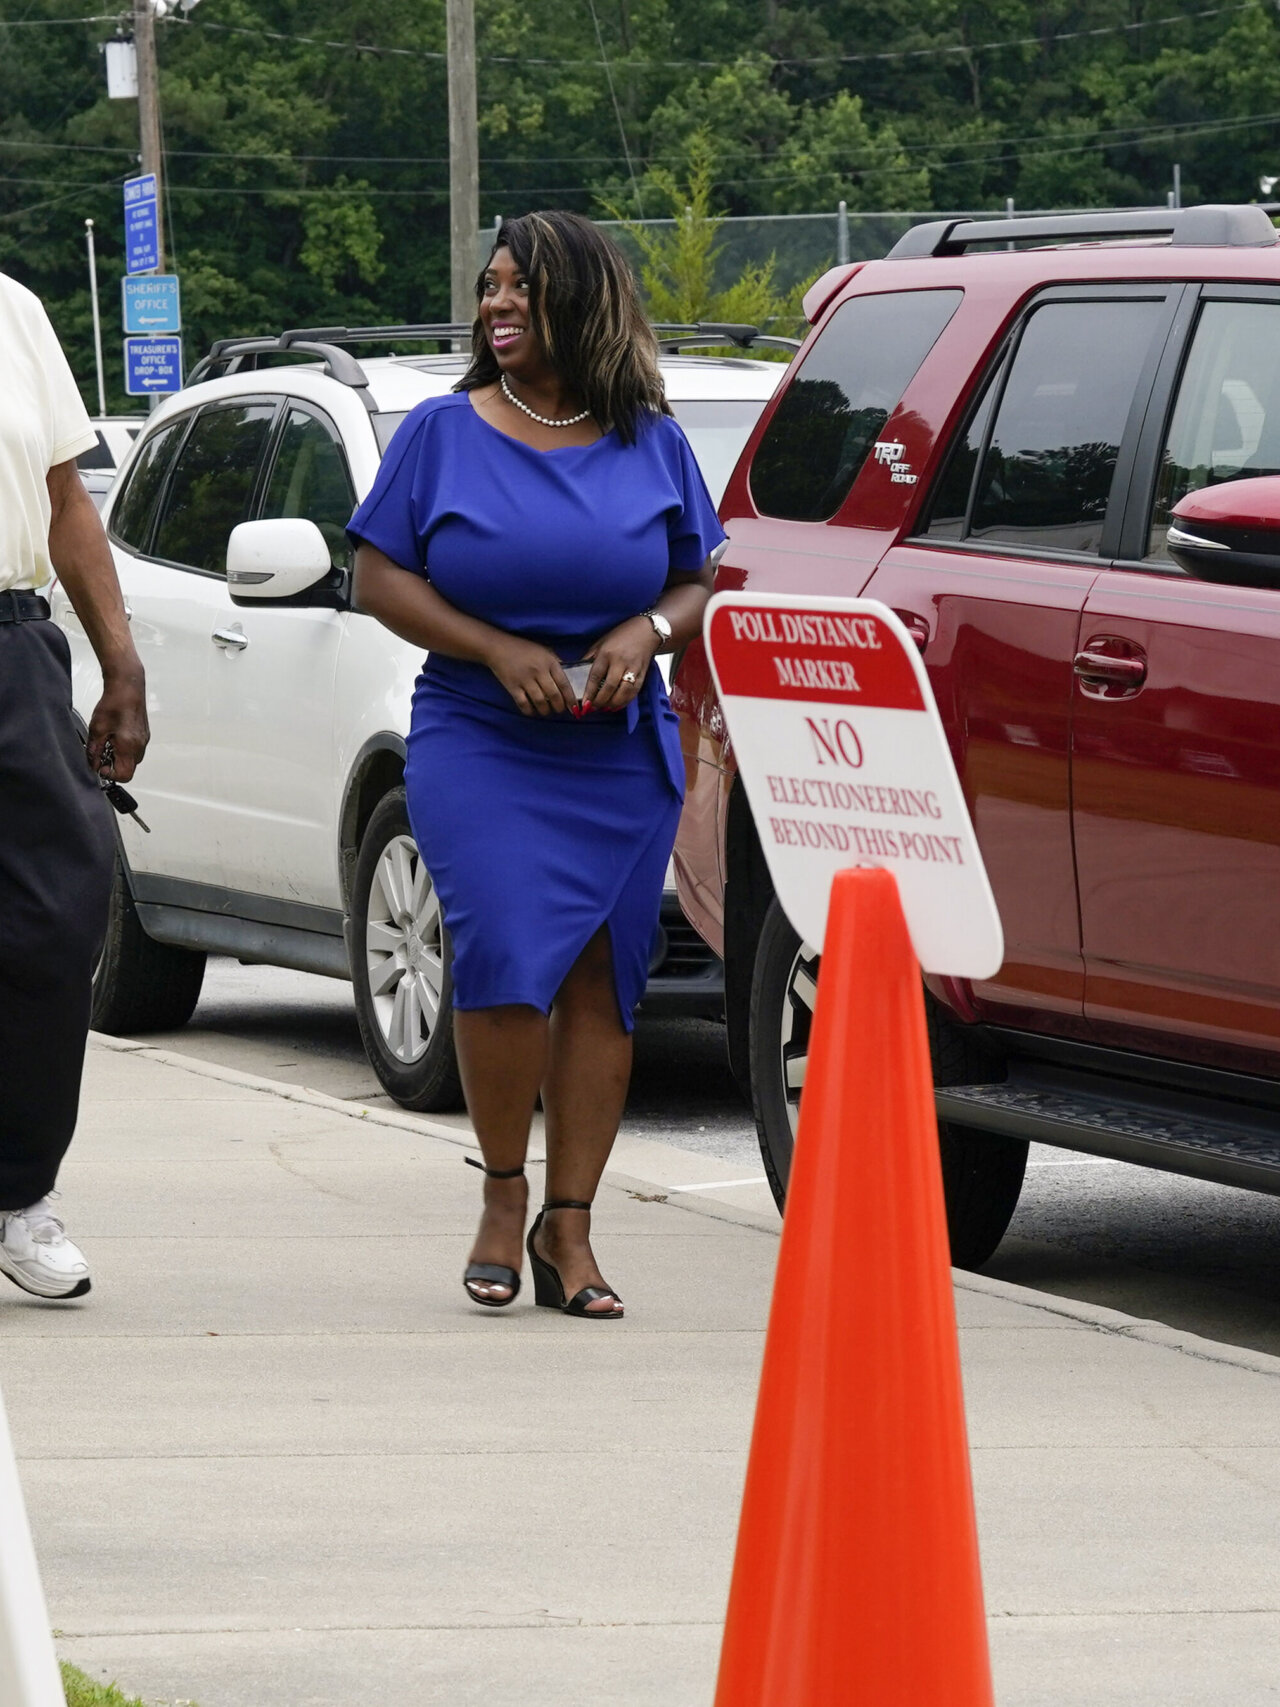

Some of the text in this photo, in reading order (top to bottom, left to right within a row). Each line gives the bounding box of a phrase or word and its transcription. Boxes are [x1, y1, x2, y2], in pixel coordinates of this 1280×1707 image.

[127, 283, 177, 294] SHERIFF'S
[134, 299, 168, 310] OFFICE
[130, 344, 178, 354] TREASURER'S
[141, 355, 166, 365] OFFICE
[134, 365, 173, 376] DROP-BOX
[874, 441, 906, 465] TRD
[890, 462, 911, 473] OFF
[891, 473, 918, 484] ROAD
[728, 610, 882, 650] POLL DISTANCE
[773, 657, 861, 692] MARKER
[804, 716, 864, 769] NO
[766, 774, 942, 820] ELECTIONEERING
[768, 816, 966, 865] BEYOND THIS POINT
